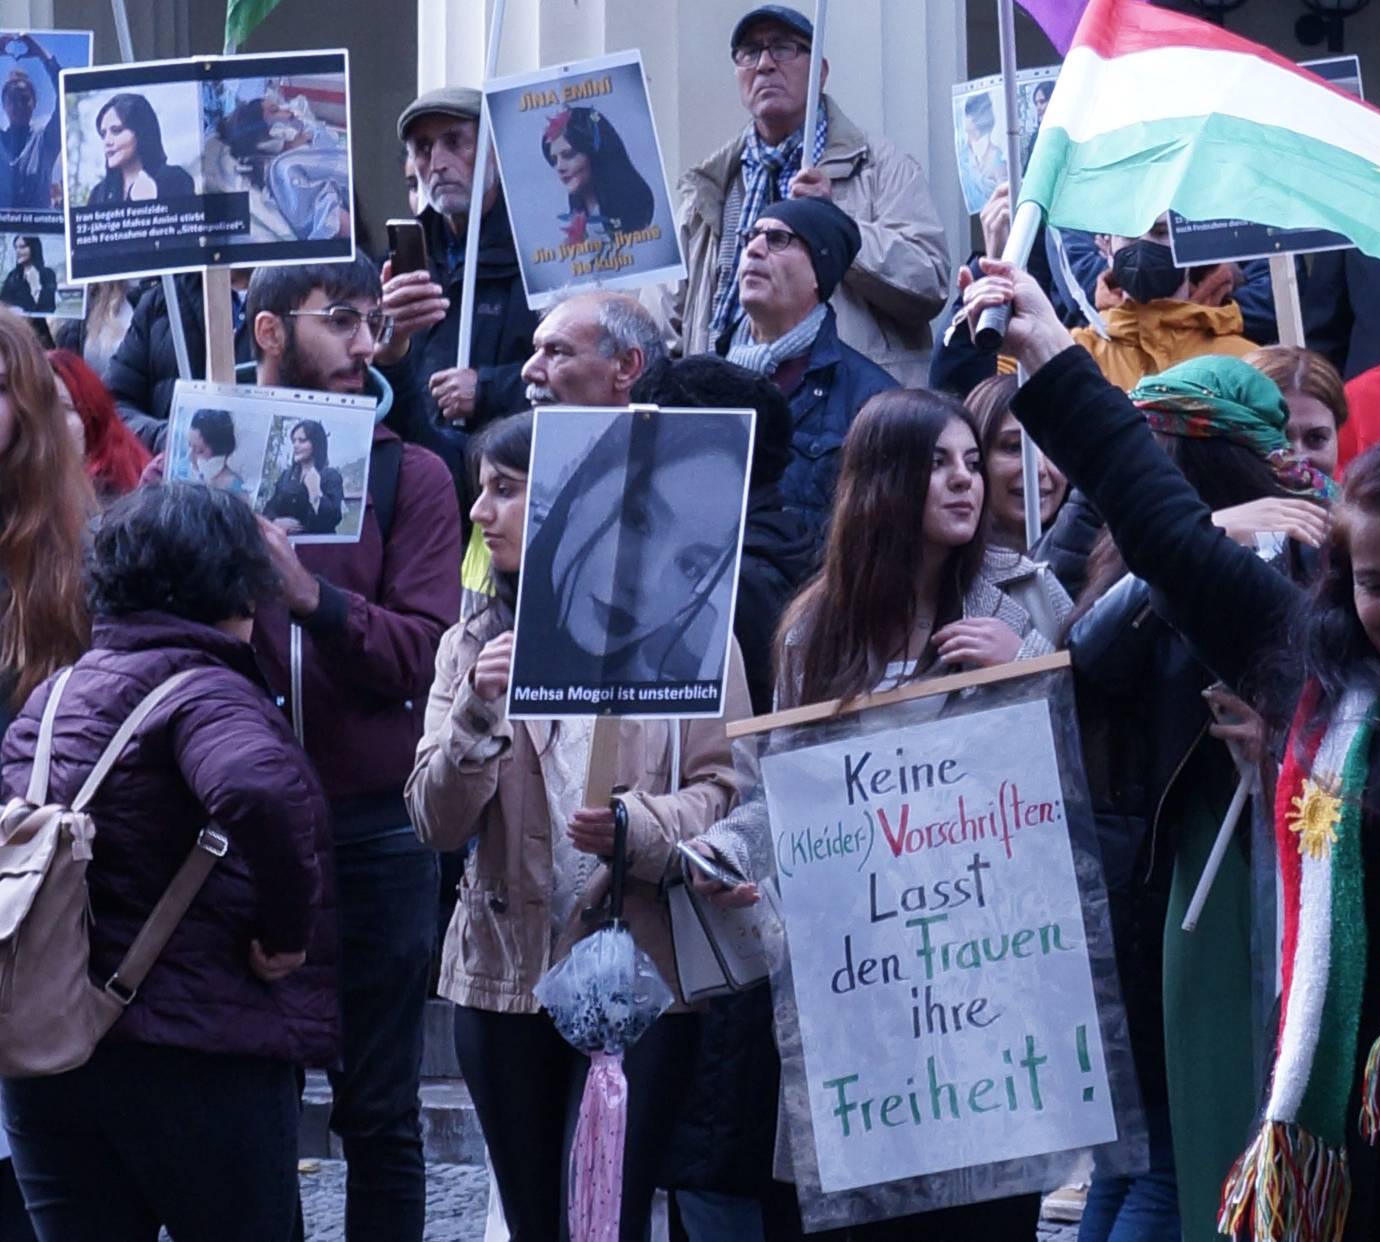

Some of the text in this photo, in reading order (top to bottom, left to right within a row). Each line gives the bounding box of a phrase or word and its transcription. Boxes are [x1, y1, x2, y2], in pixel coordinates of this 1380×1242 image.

[75, 204, 168, 223] Iran begeht Femizide:
[76, 233, 98, 245] nach
[100, 228, 147, 243] Festnahme
[149, 224, 175, 237] durch
[152, 213, 178, 226] Amini
[179, 211, 205, 222] stirbt
[515, 685, 564, 701] Mehsa
[617, 685, 635, 701] ist
[638, 684, 718, 701] unsterblich
[844, 748, 970, 805] Keine
[876, 779, 1062, 860] Vorschriften:
[869, 852, 991, 923] Lasst
[831, 912, 1076, 994] den Frauen
[911, 985, 1002, 1039] ihre
[822, 1034, 1048, 1137] Freiheit
